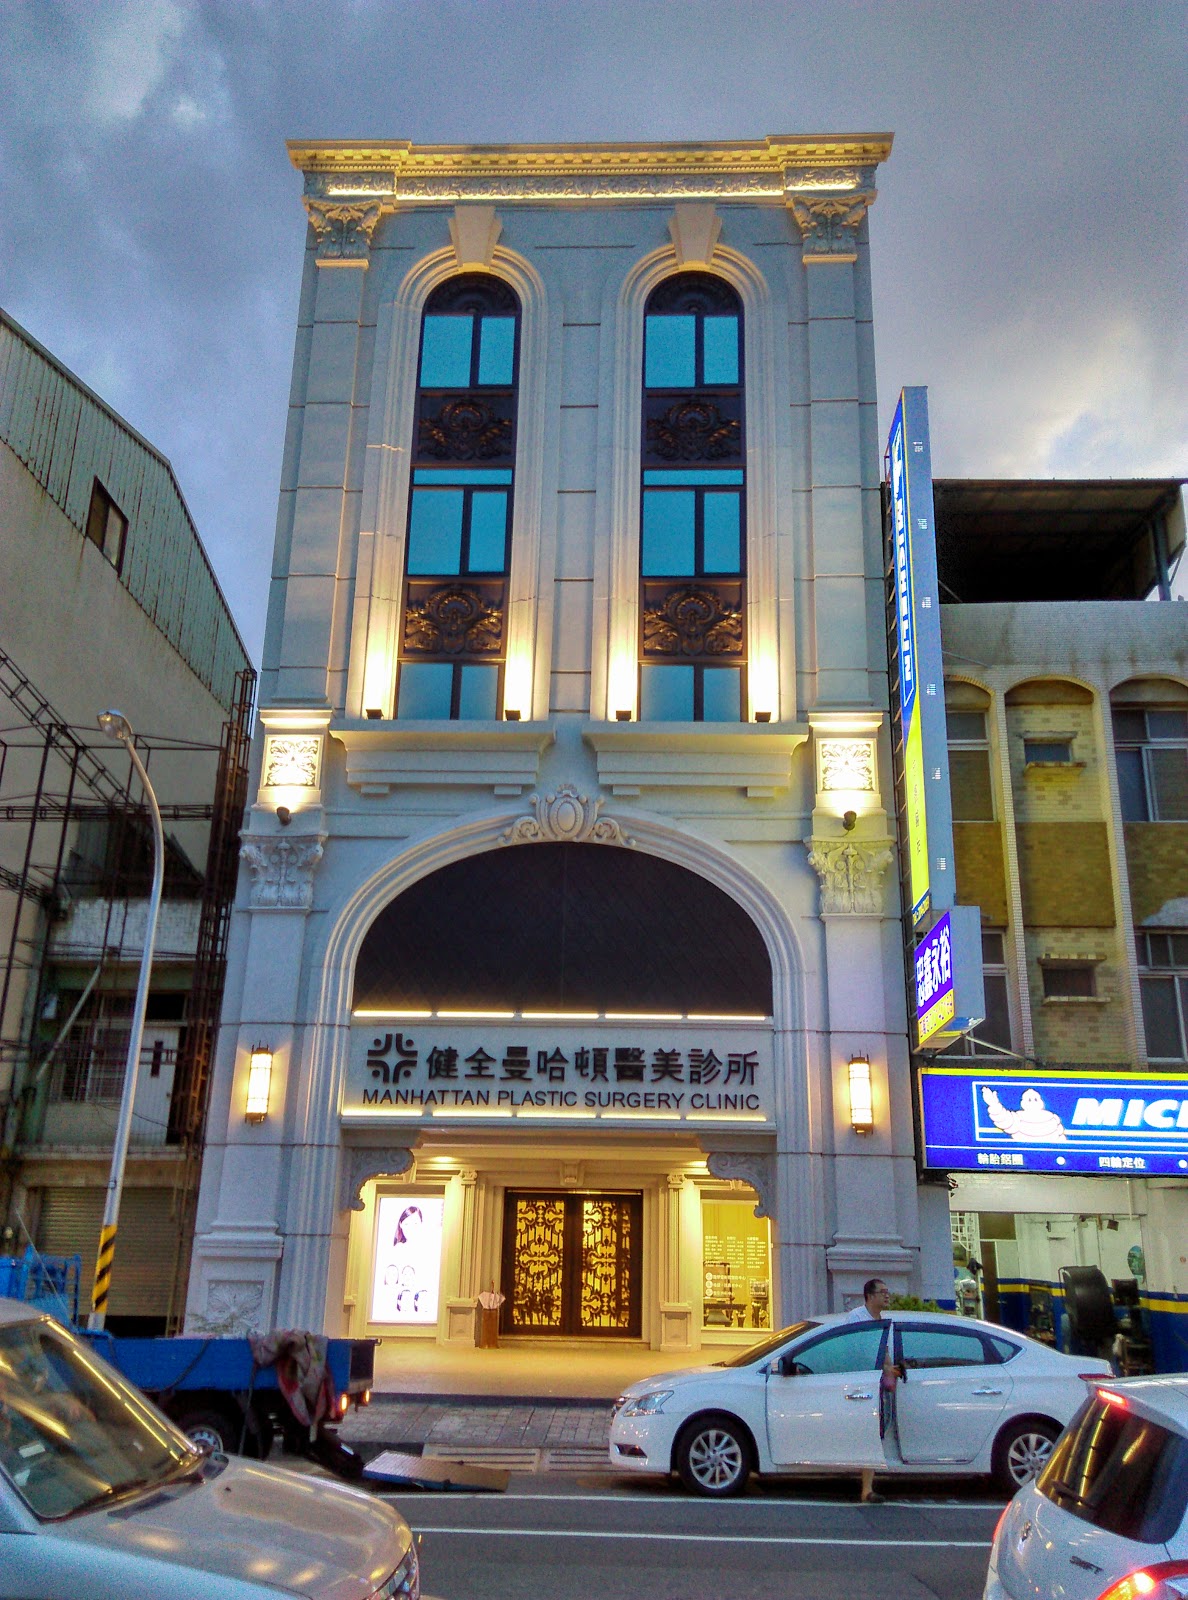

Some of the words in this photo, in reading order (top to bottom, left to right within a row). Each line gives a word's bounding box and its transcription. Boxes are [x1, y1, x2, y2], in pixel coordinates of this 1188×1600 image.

[896, 498, 912, 682] MICHELIN
[426, 1046, 759, 1085] 健全曼哈頓醫美診所
[362, 1089, 490, 1106] MANHATTAN
[497, 1090, 577, 1107] PLASTIC
[584, 1091, 685, 1109] SURGERY
[690, 1093, 760, 1111] CLINIC
[1098, 1156, 1146, 1169] 四輪定位
